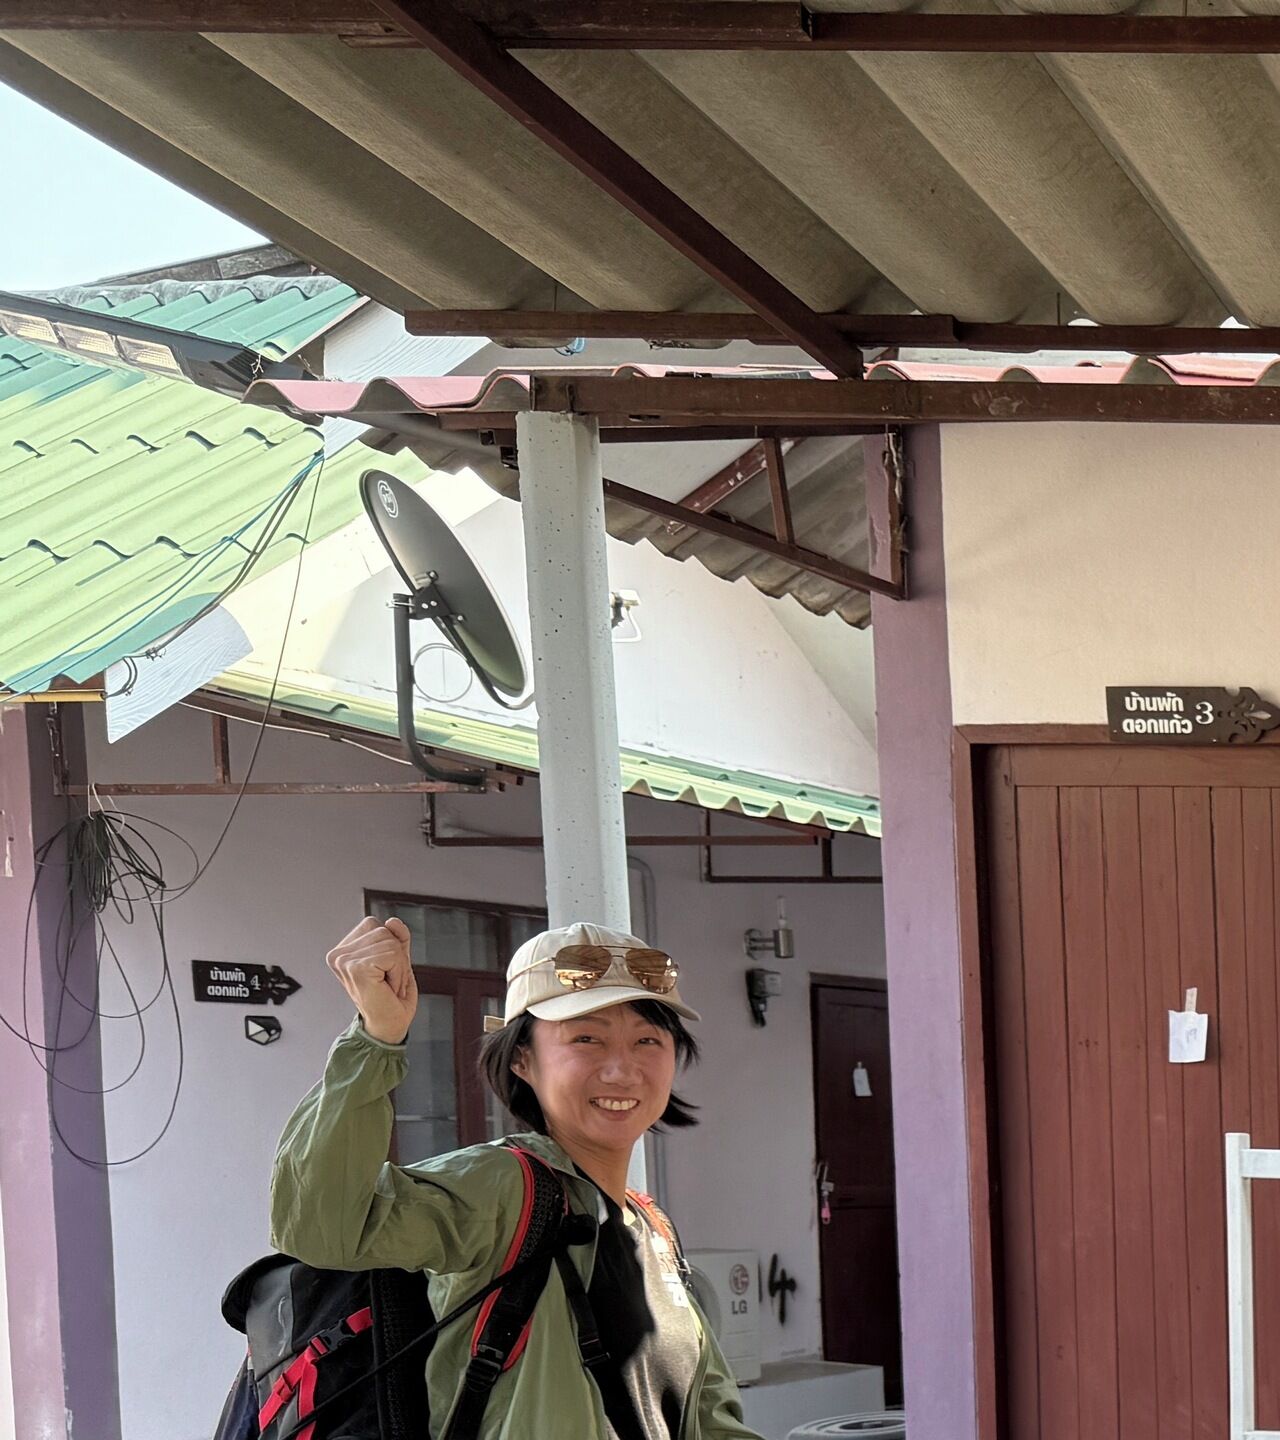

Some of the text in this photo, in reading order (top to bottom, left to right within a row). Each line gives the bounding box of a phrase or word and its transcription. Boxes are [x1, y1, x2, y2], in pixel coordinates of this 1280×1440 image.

[1124, 691, 1184, 712] บ้านพัก
[1195, 701, 1214, 725] 3
[1122, 714, 1193, 734] ดอกแก้ว
[250, 975, 261, 991] 4
[731, 1299, 748, 1315] LG
